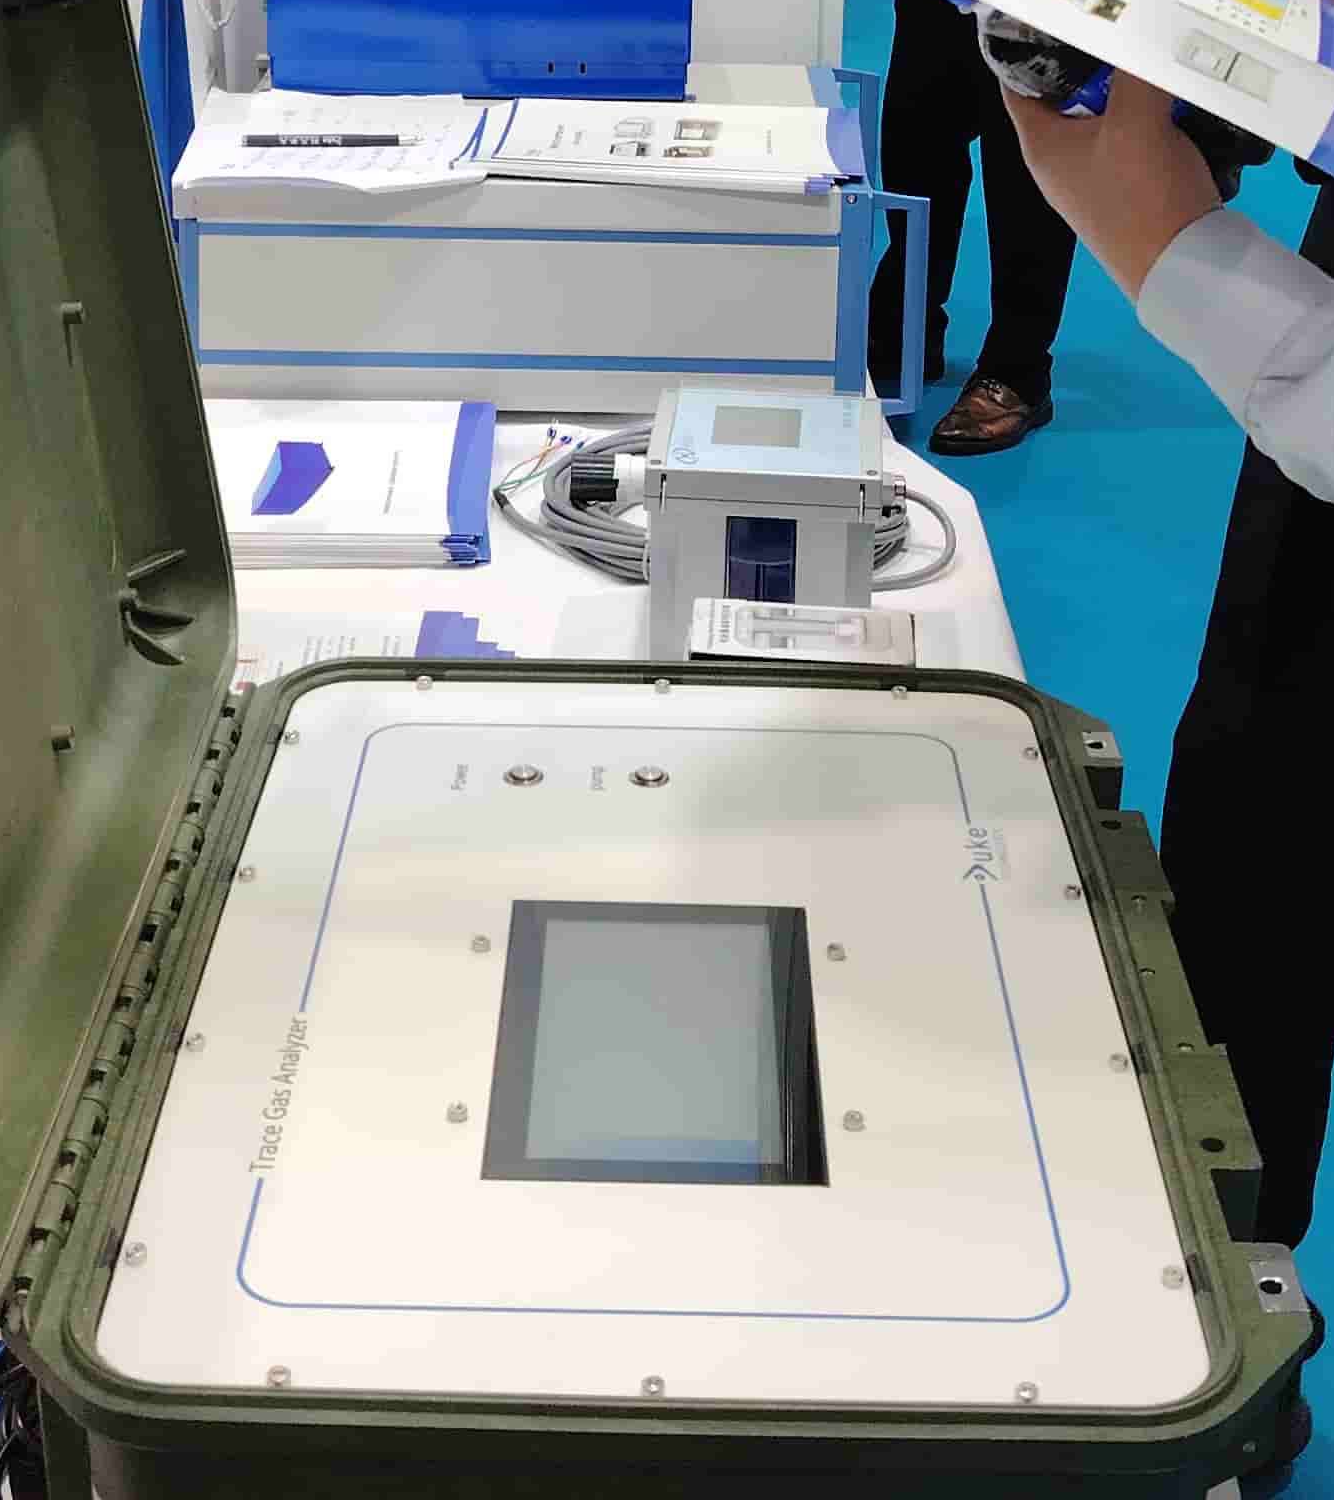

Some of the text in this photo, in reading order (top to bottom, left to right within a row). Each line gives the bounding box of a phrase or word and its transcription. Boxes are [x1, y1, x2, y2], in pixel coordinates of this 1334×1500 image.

[248, 1013, 310, 1173] Trace Gas Analyzer
